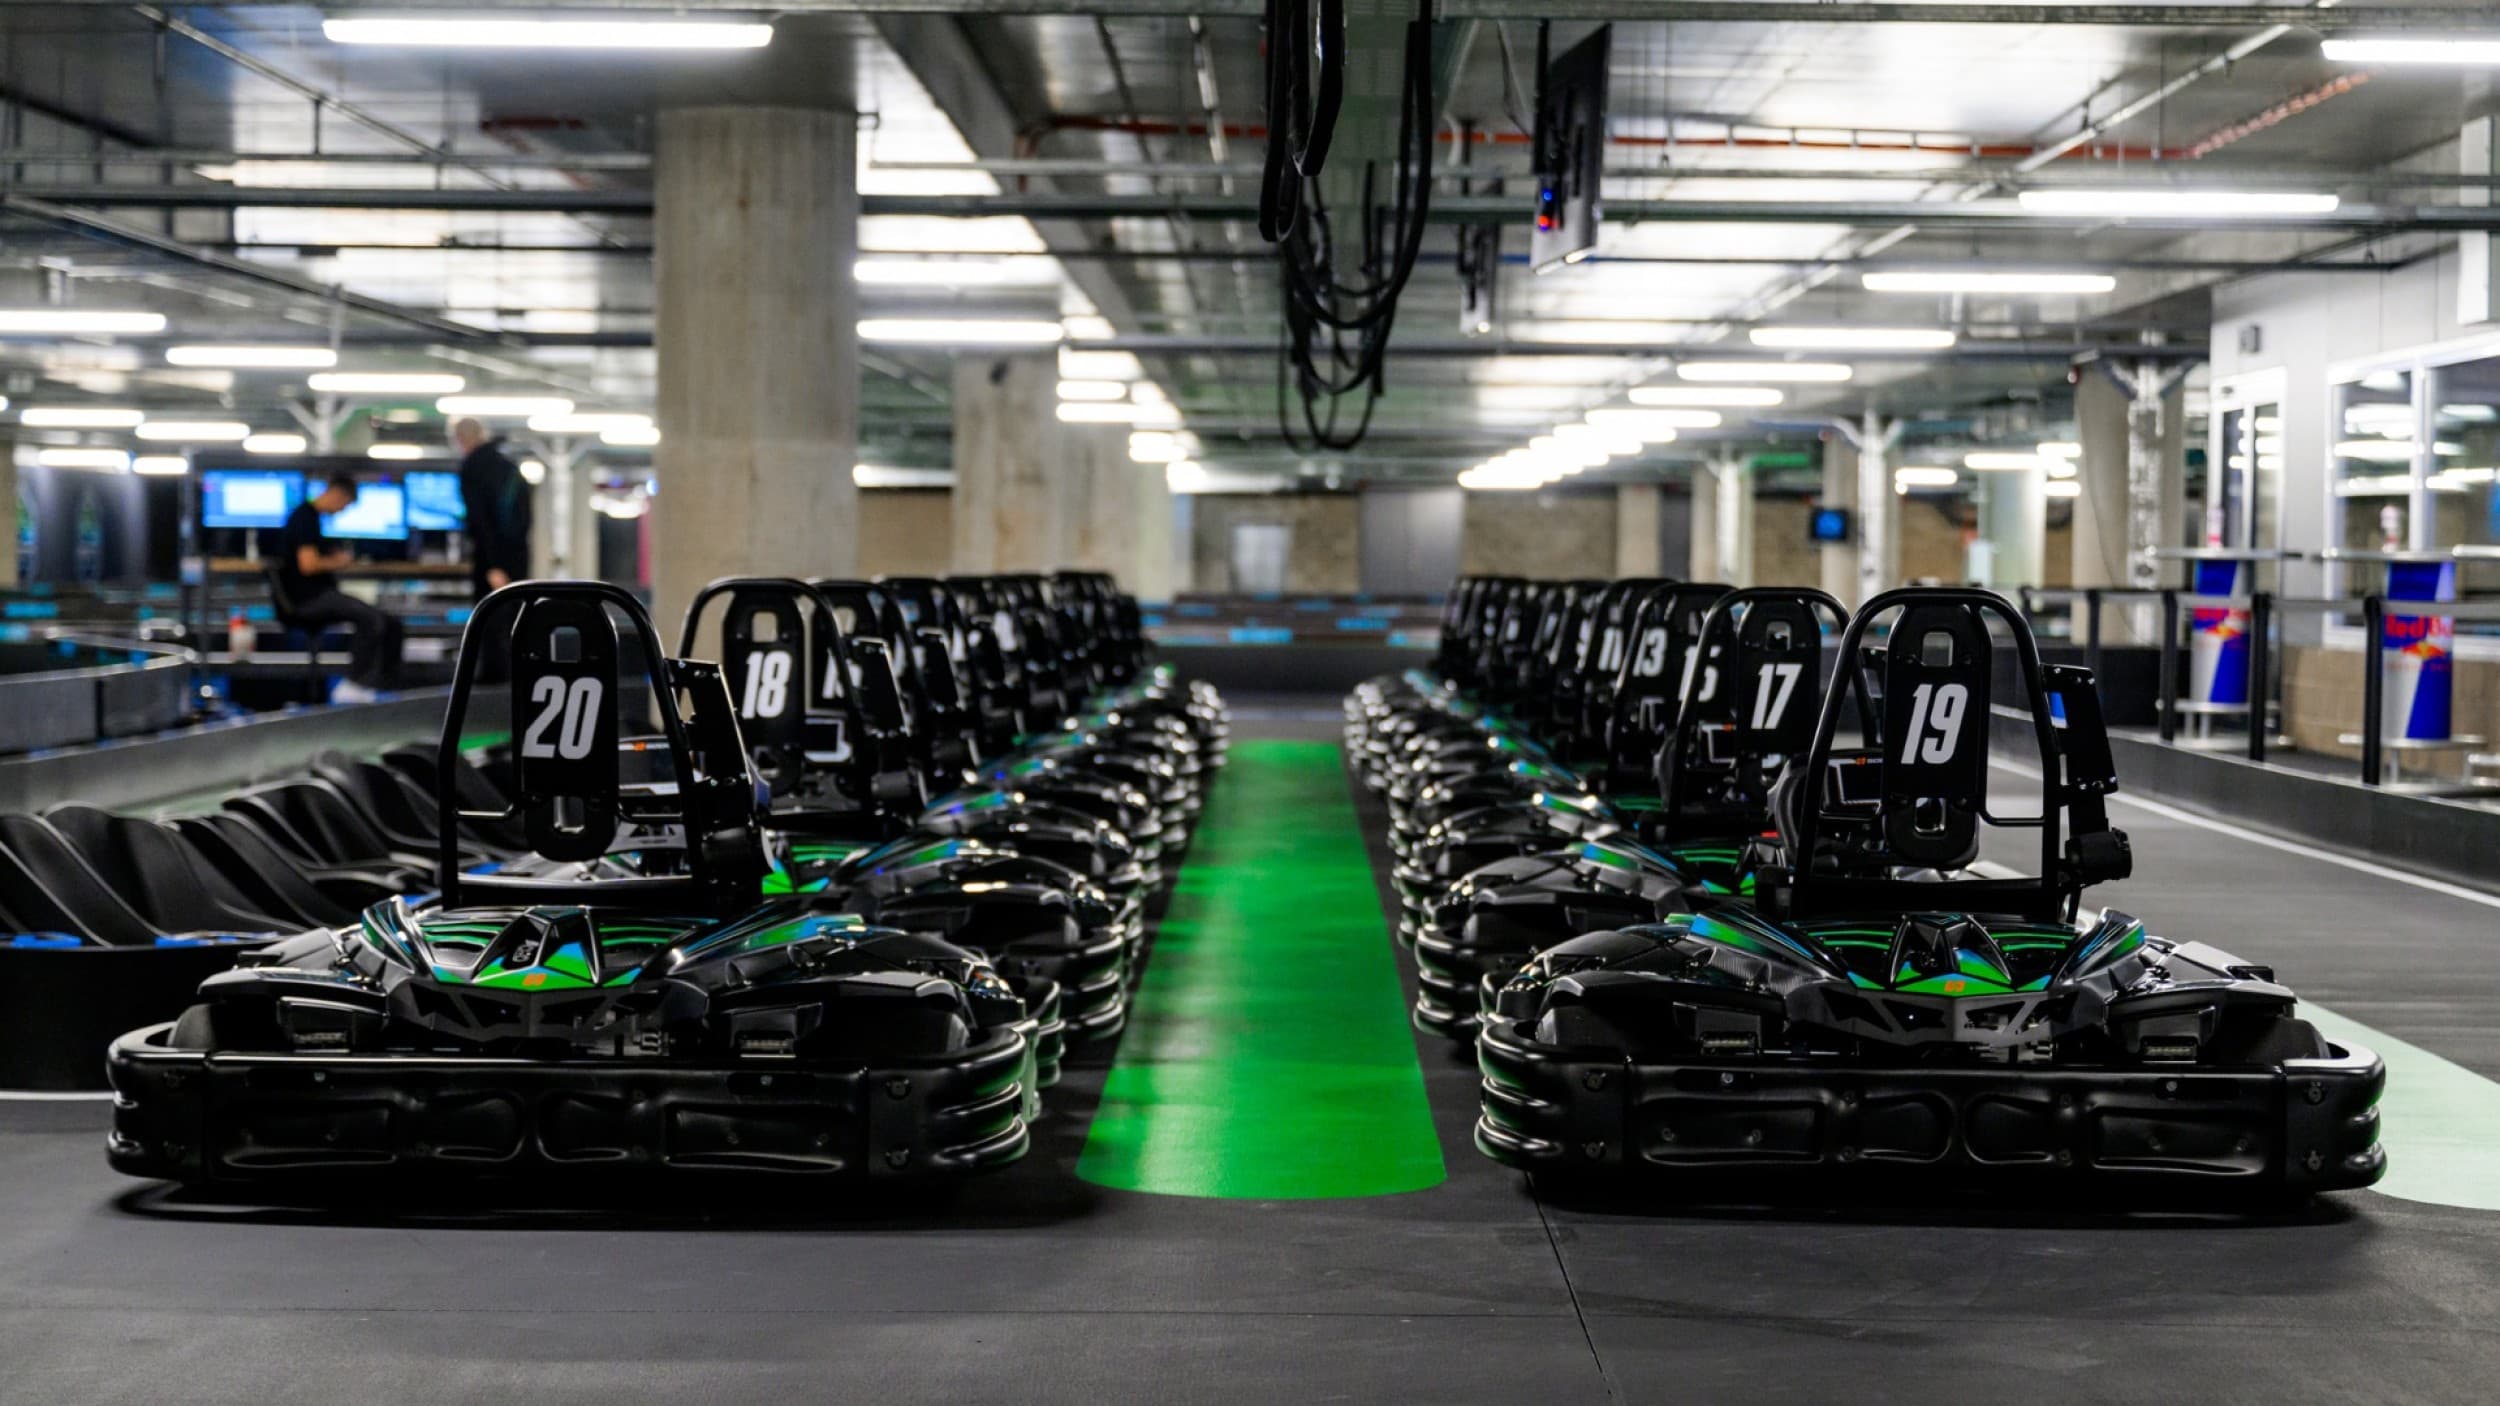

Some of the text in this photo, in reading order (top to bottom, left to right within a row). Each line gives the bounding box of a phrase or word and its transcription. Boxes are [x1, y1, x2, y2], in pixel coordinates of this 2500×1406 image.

[741, 650, 793, 719] 18
[1632, 626, 1668, 677] 13
[521, 674, 604, 760] 20
[1750, 662, 1803, 730] 17
[1900, 683, 1969, 764] 19
